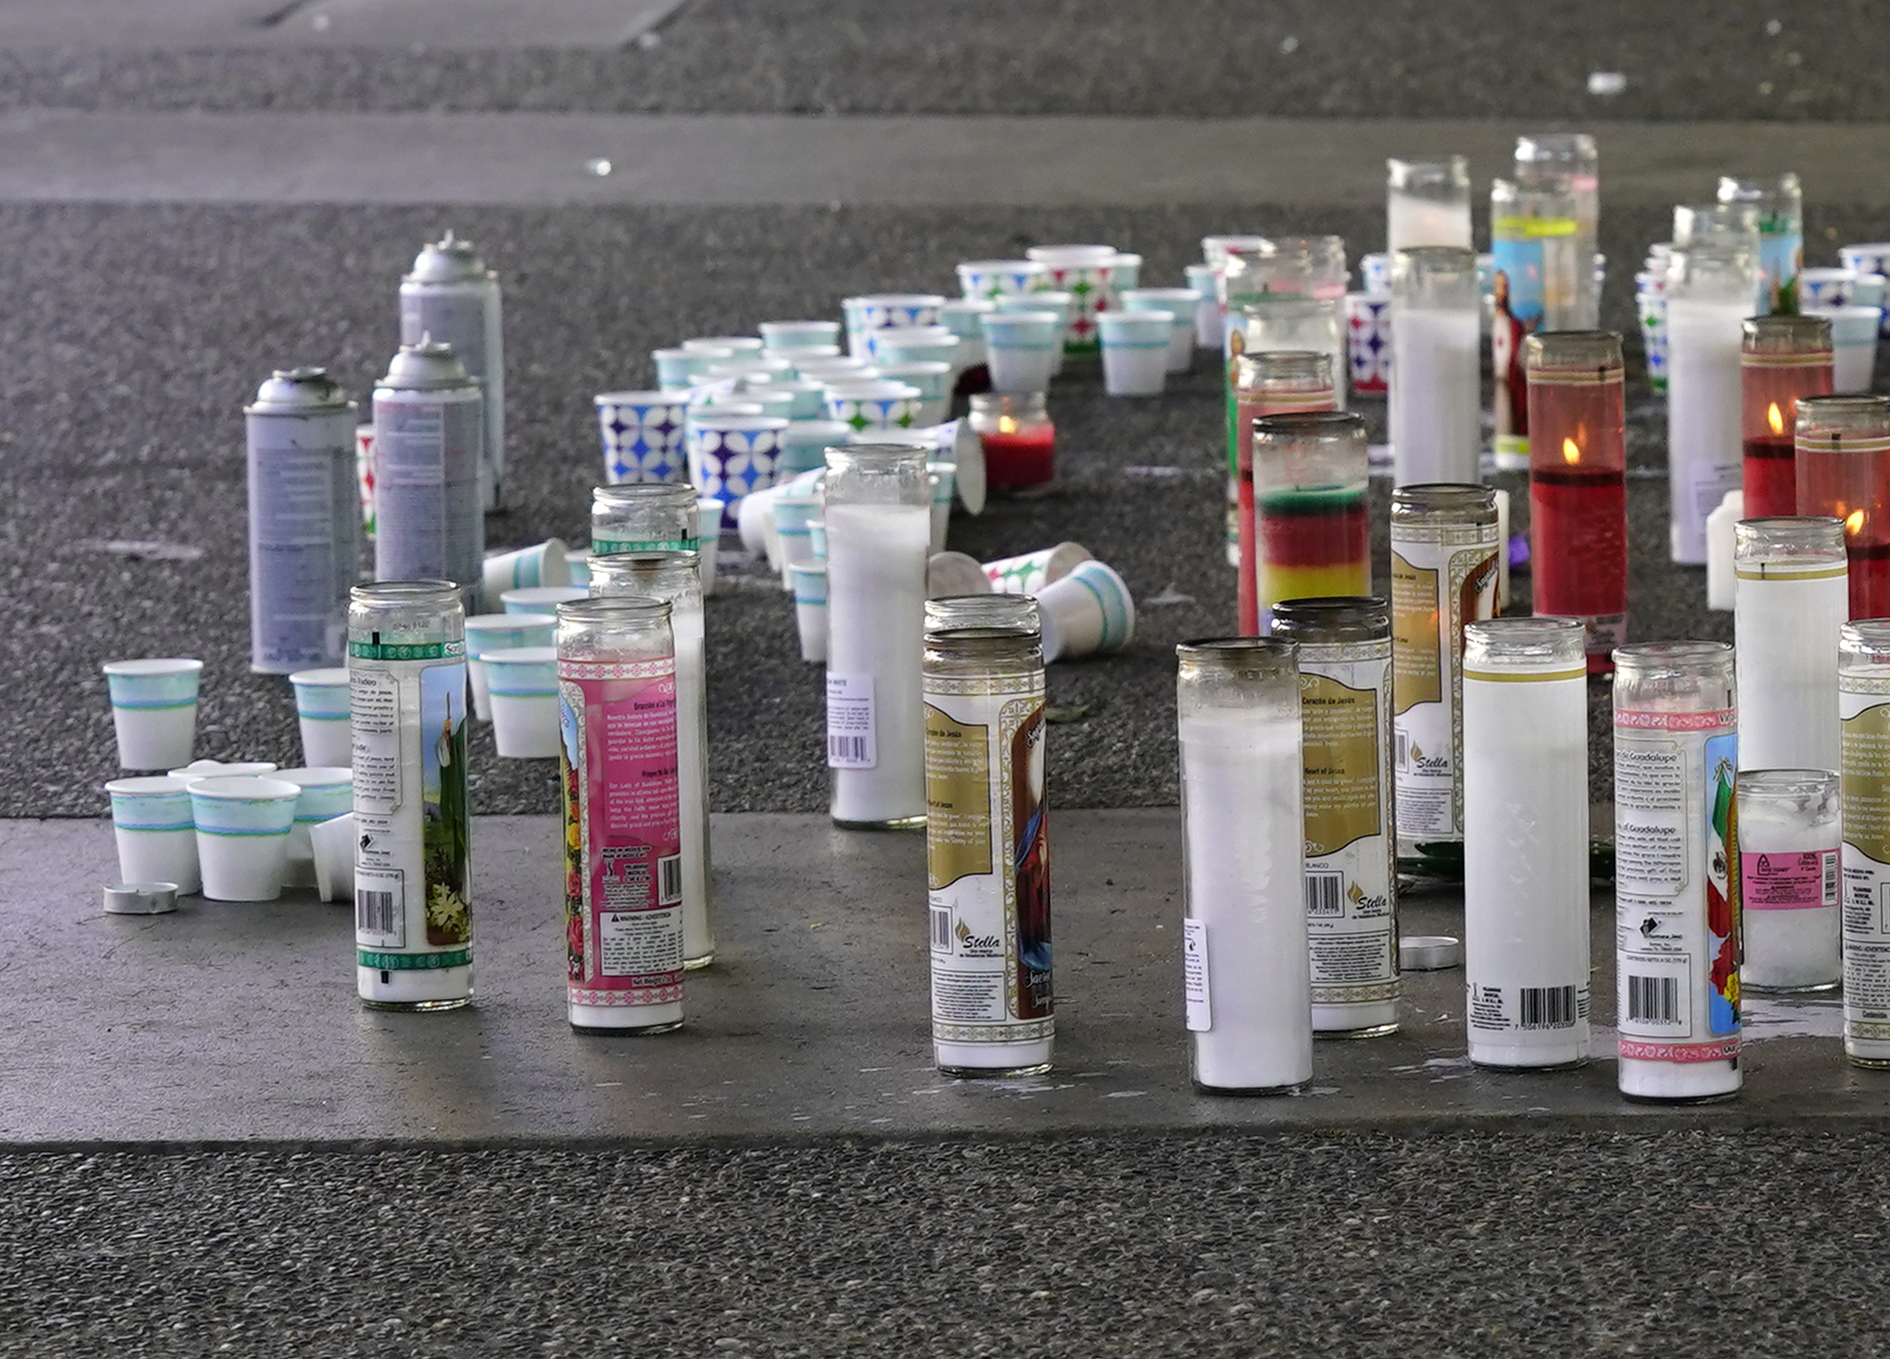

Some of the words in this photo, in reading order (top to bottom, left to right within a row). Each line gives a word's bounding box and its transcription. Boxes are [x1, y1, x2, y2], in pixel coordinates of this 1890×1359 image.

[1629, 752, 1678, 764] Guadalupe
[1629, 824, 1676, 836] Guadalupe
[1356, 894, 1387, 911] Stella
[962, 934, 1000, 949] Stella
